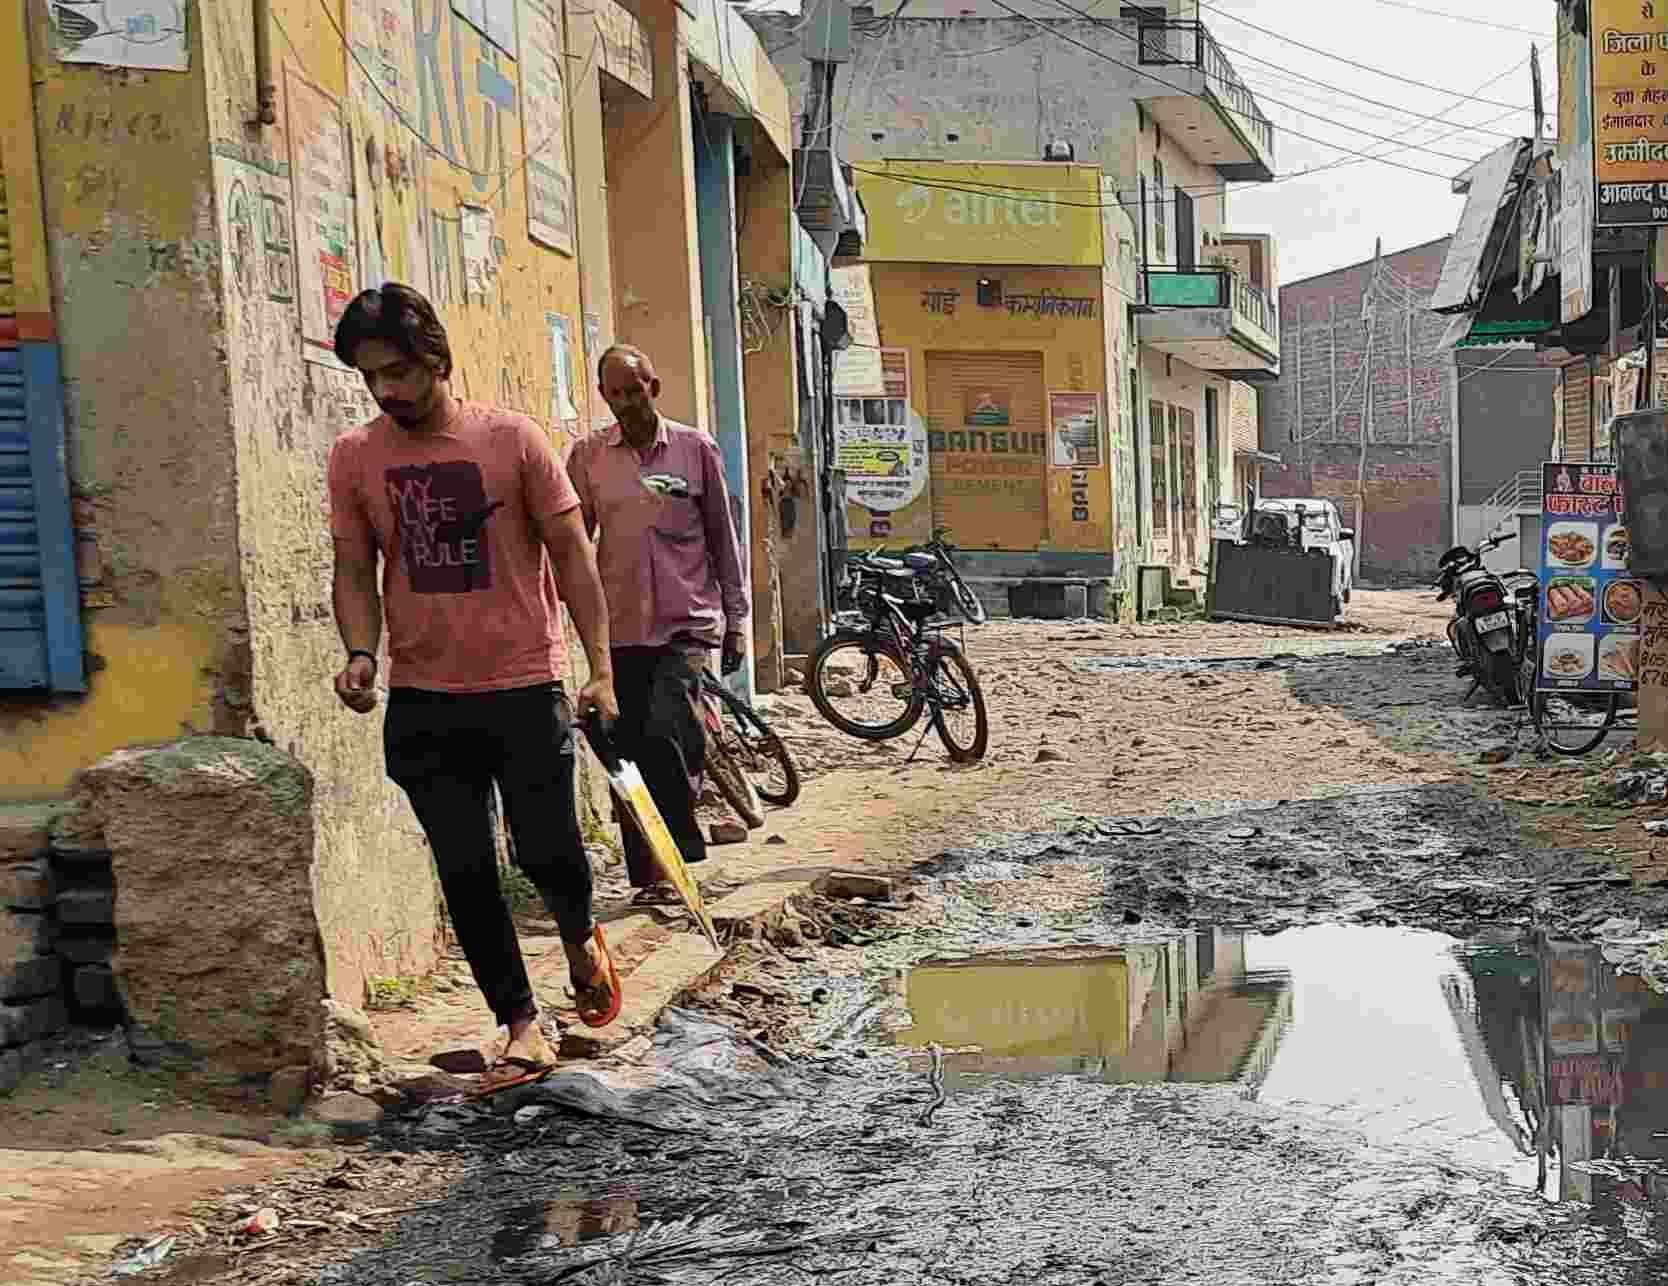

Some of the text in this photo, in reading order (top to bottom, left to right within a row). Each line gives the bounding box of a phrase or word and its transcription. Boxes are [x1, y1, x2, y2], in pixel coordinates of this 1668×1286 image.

[1601, 29, 1652, 53] जिला
[1640, 60, 1656, 77] के
[943, 188, 1058, 225] airtel
[389, 478, 433, 504] MY
[400, 496, 457, 525] LIFE
